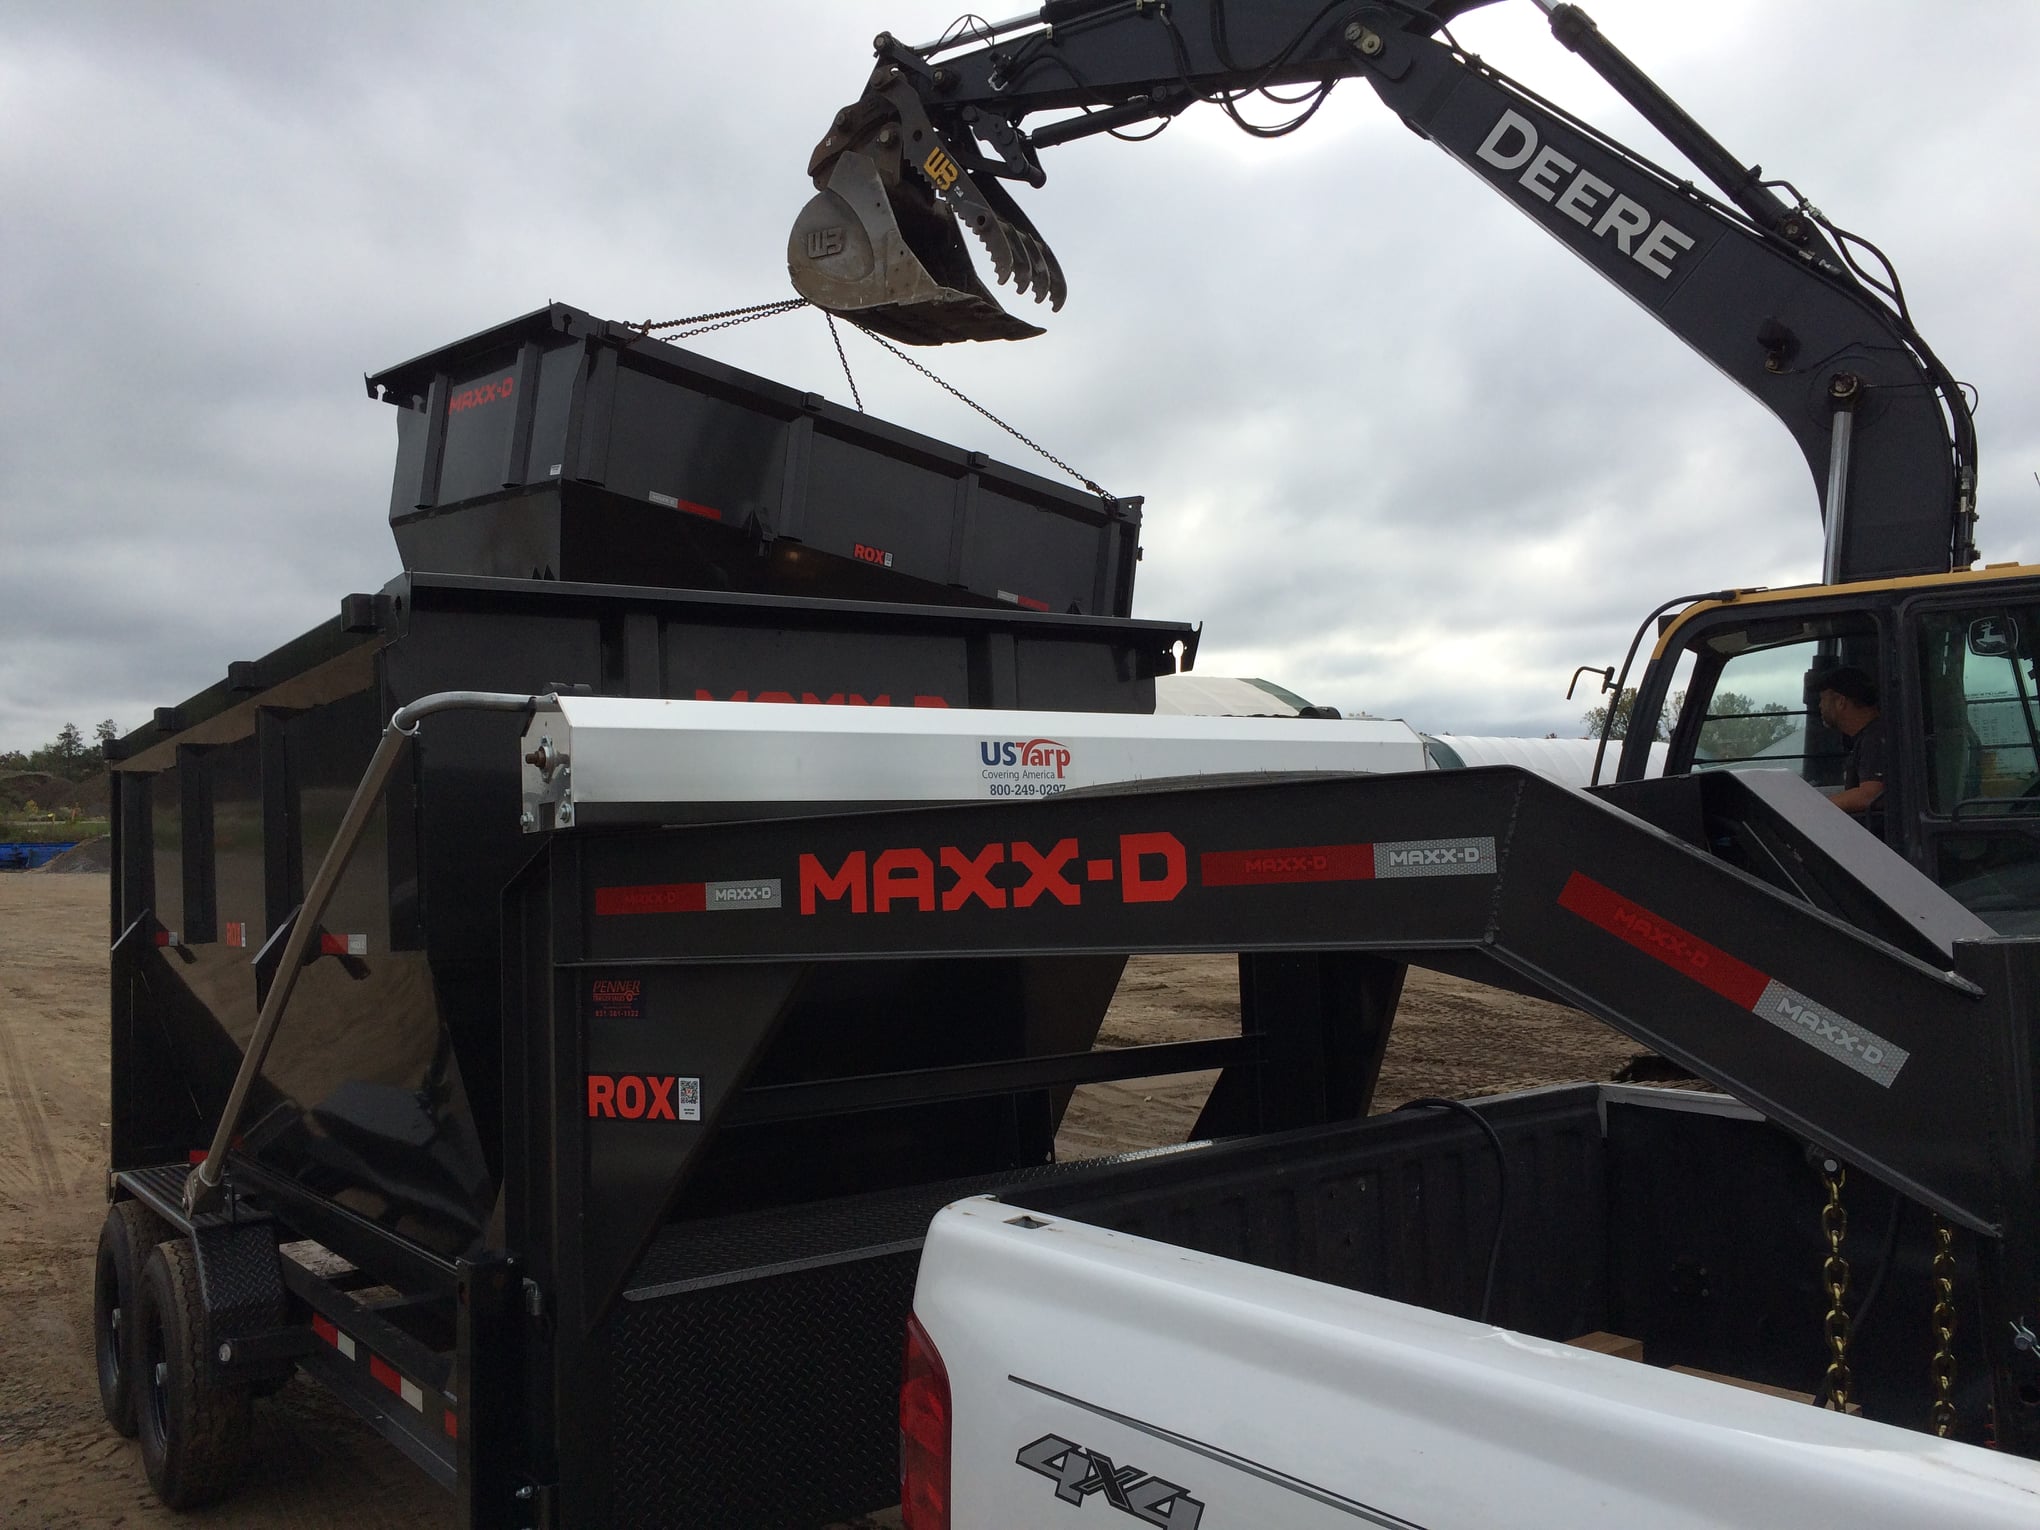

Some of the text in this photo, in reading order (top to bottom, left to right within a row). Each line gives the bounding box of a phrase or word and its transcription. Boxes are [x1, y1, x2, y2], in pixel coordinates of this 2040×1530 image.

[1476, 108, 1695, 279] DEERE
[853, 543, 885, 565] ROX
[981, 769, 1056, 782] Covering America
[1244, 846, 1481, 873] MAXX-D MAXX-D
[800, 832, 1187, 915] MAXX-D
[714, 886, 772, 902] MAXX-D
[592, 979, 641, 993] PENNER
[1613, 905, 1886, 1066] MAXX-D MAXX-D
[588, 1075, 677, 1120] ROX
